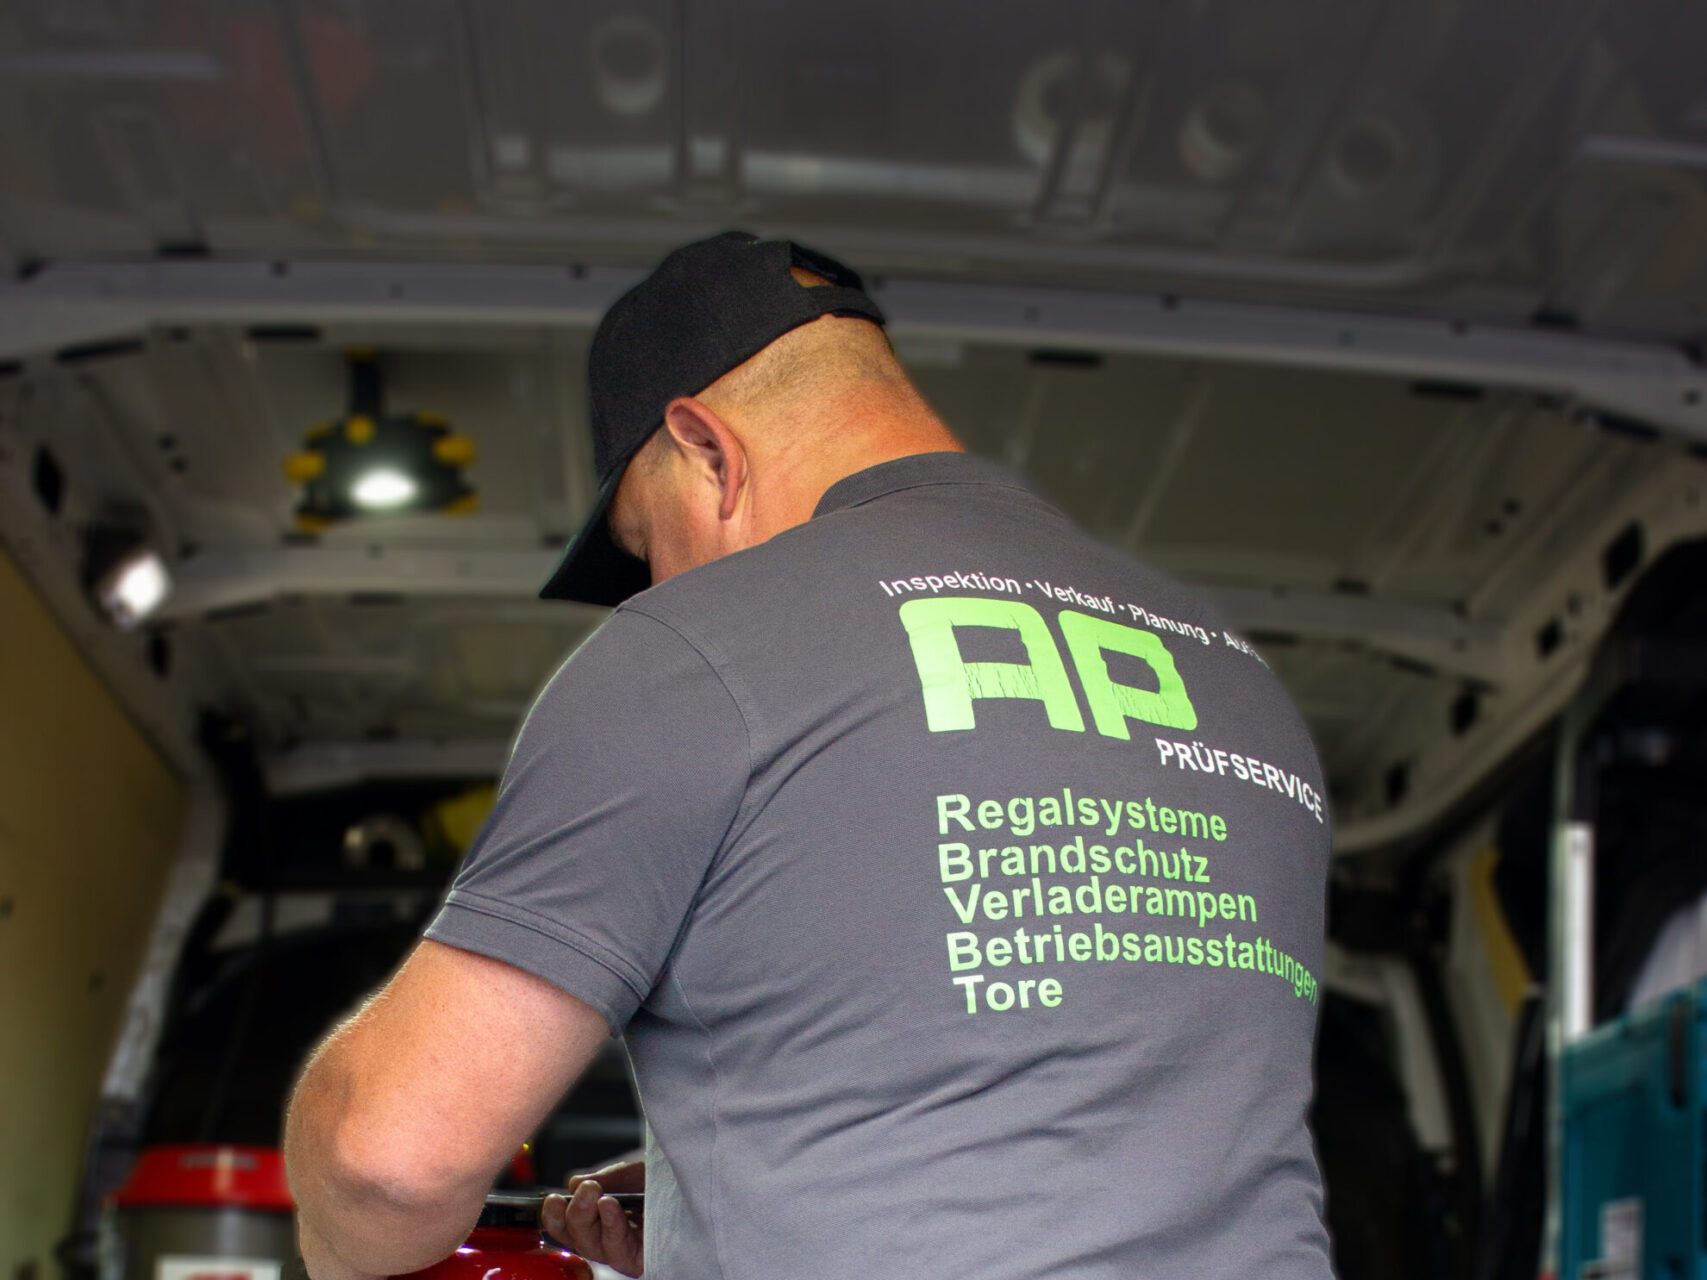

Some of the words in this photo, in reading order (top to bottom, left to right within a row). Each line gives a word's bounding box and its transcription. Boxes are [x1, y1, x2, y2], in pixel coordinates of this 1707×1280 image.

[879, 571, 1022, 597] Inspektion
[1034, 580, 1115, 614] Verkauf
[1127, 603, 1210, 646] Planung
[899, 597, 1199, 740] AP
[1155, 738, 1323, 824] PRÜFSERVICE
[936, 788, 1228, 842] Regalsysteme
[937, 835, 1211, 884] Brandschutz
[943, 876, 1258, 928] Verladerampen
[946, 923, 1318, 1006] Betriebsausstattungen
[952, 974, 1063, 1014] Tore
